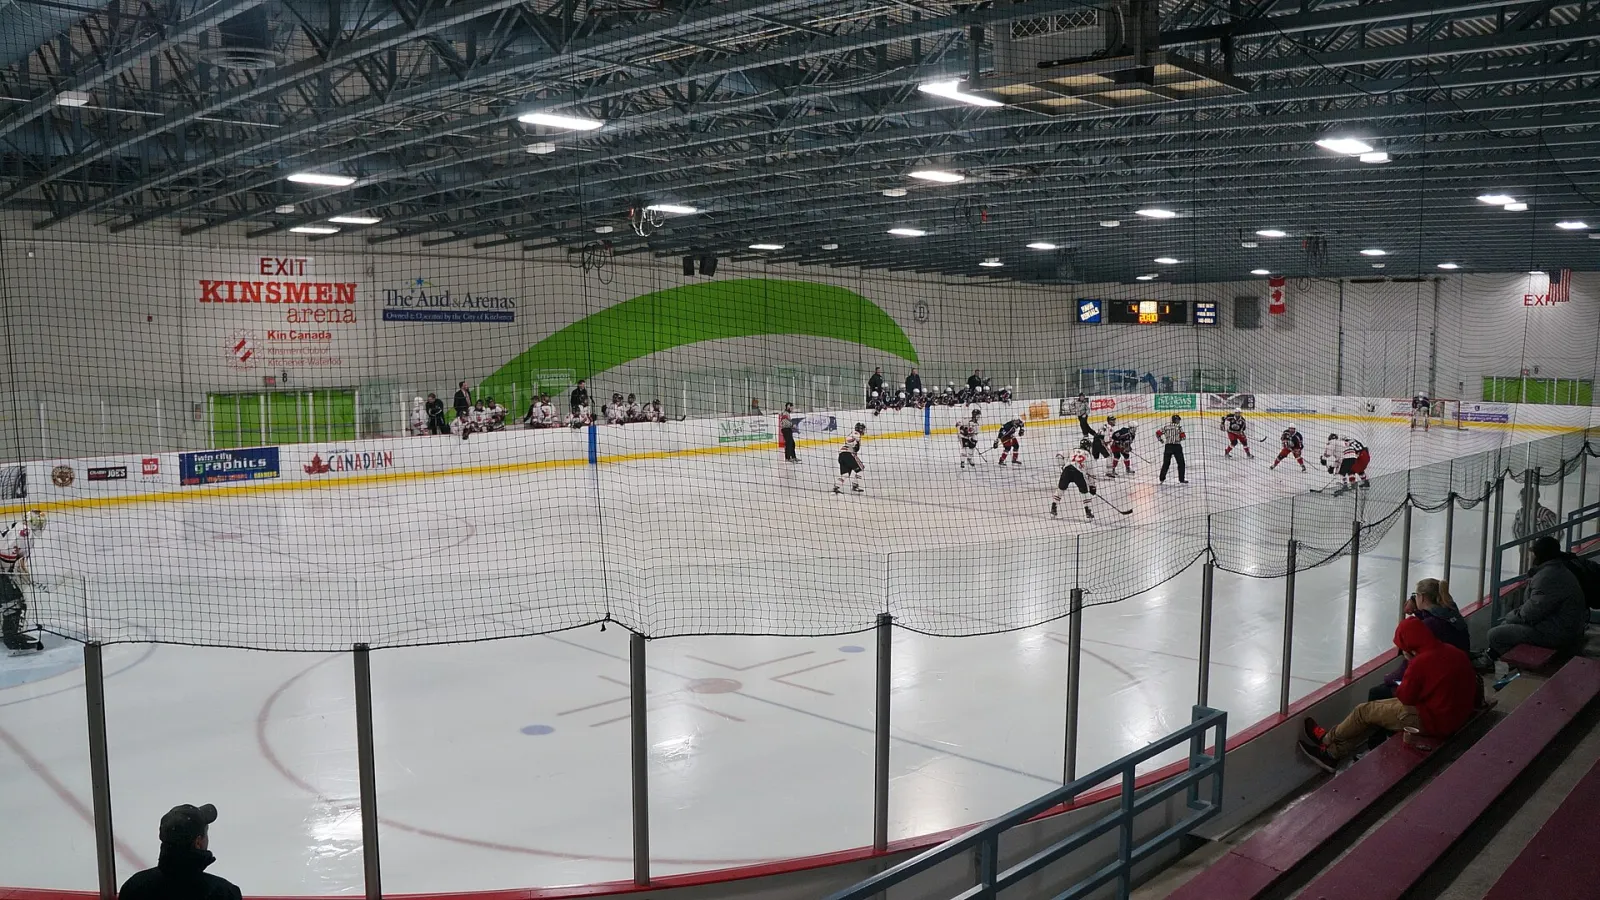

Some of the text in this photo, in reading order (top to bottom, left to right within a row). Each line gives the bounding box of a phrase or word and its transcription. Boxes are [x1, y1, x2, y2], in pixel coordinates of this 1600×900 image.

[260, 257, 307, 276] EXIT
[199, 280, 357, 304] KINSMEN
[383, 288, 413, 307] The
[416, 290, 450, 308] Aud
[462, 292, 516, 309] Arenas
[287, 307, 357, 324] arena
[1131, 304, 1138, 313] 4
[267, 330, 332, 340] Kin Canada
[194, 452, 232, 462] twin city
[194, 457, 267, 474] graphics
[328, 451, 393, 472] CANADIAN
